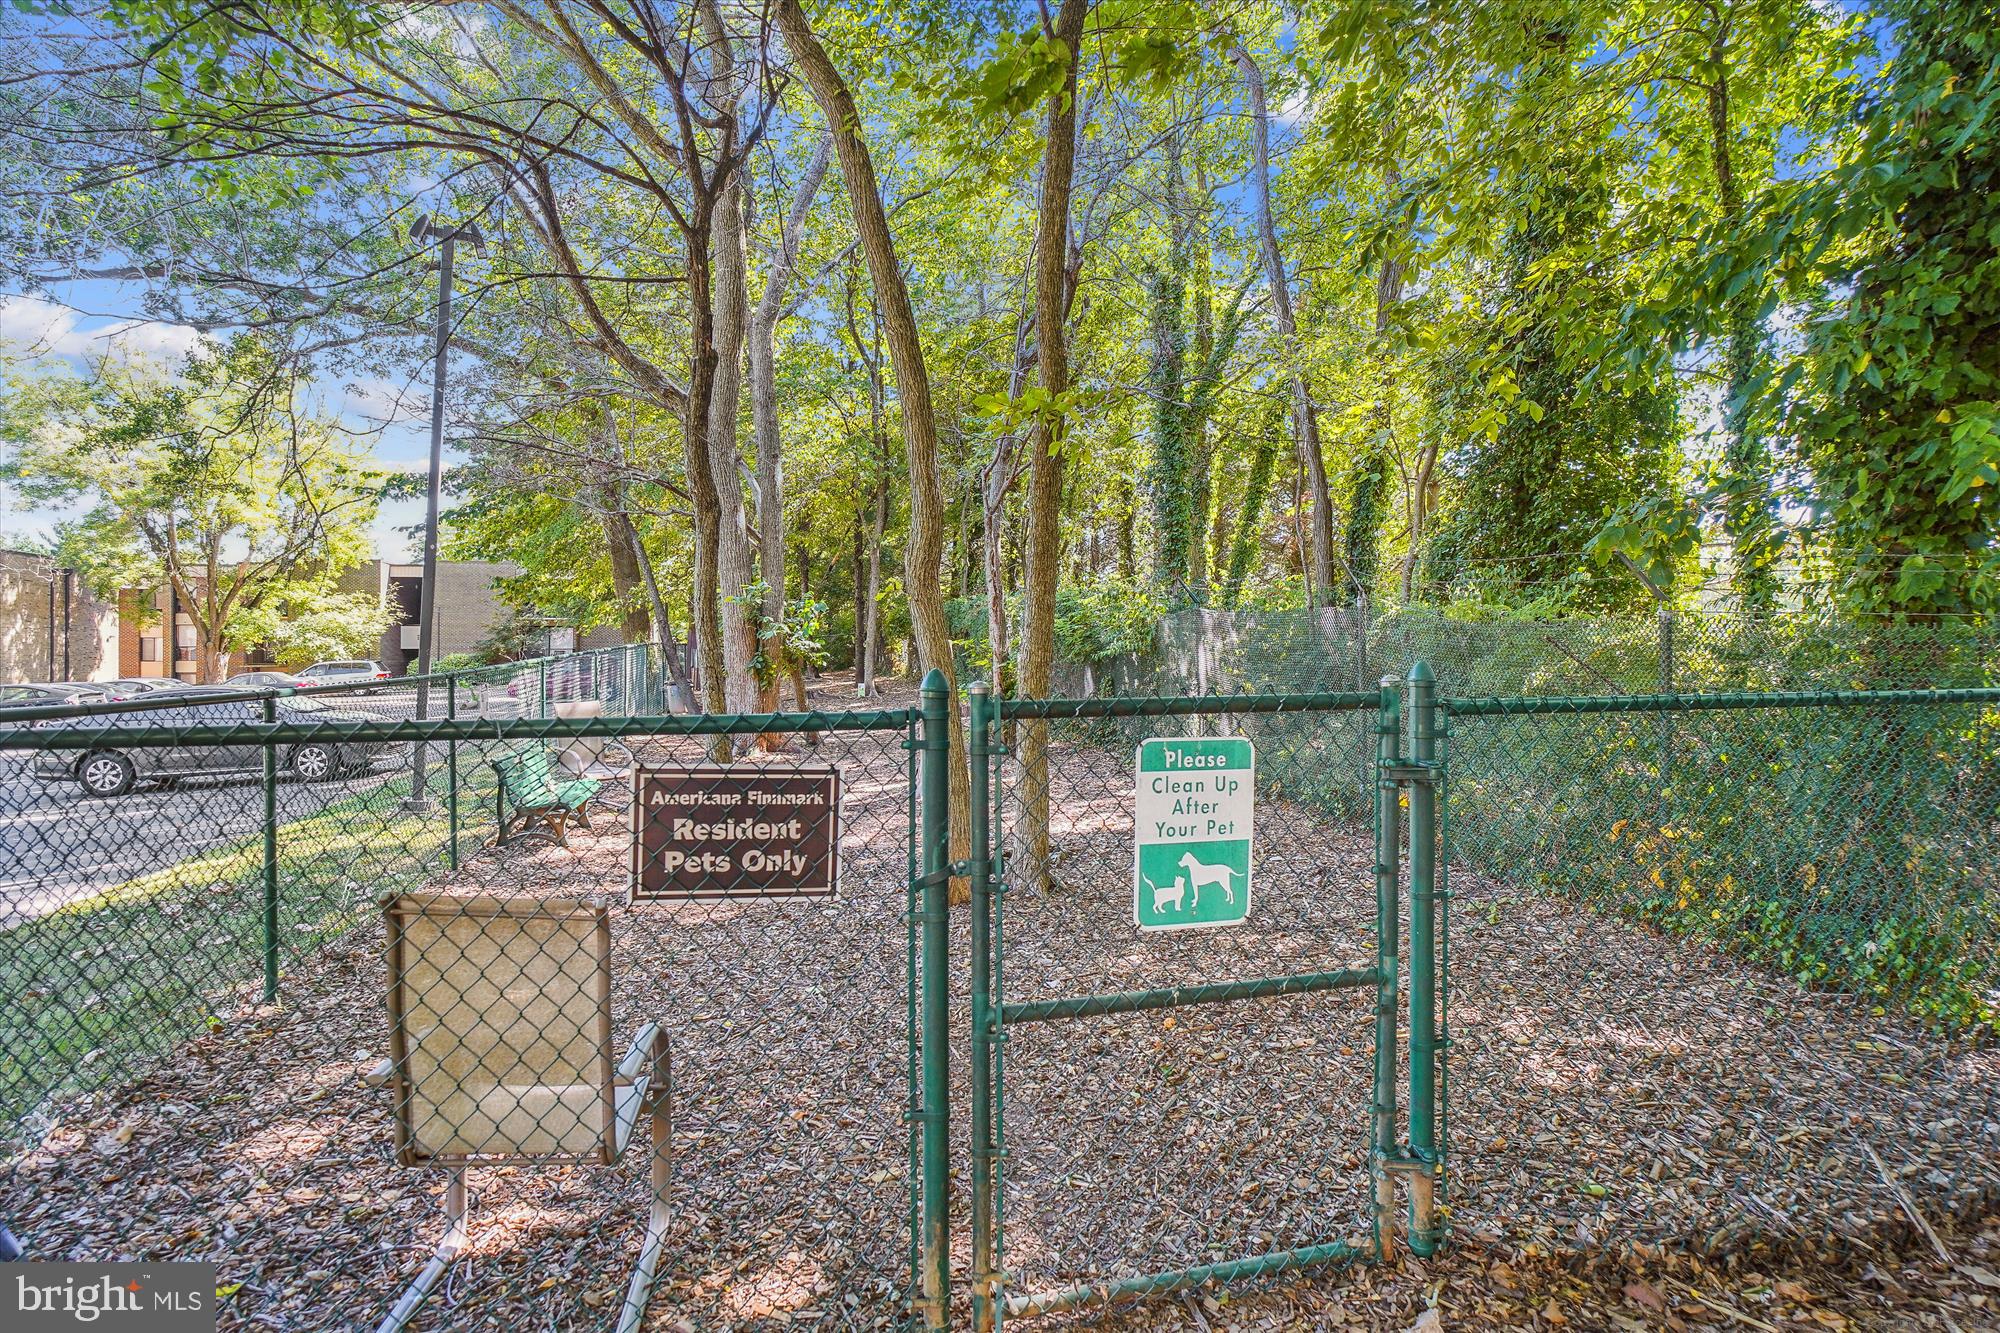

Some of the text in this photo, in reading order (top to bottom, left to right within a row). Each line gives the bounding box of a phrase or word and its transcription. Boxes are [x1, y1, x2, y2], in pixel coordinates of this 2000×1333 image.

[1164, 749, 1227, 768] Please
[1152, 776, 1239, 796] Clean Up
[651, 790, 742, 805] Americana
[1172, 797, 1219, 815] After
[673, 818, 802, 841] Resident
[1155, 820, 1235, 838] Your Pet
[664, 849, 808, 876] Pets Only
